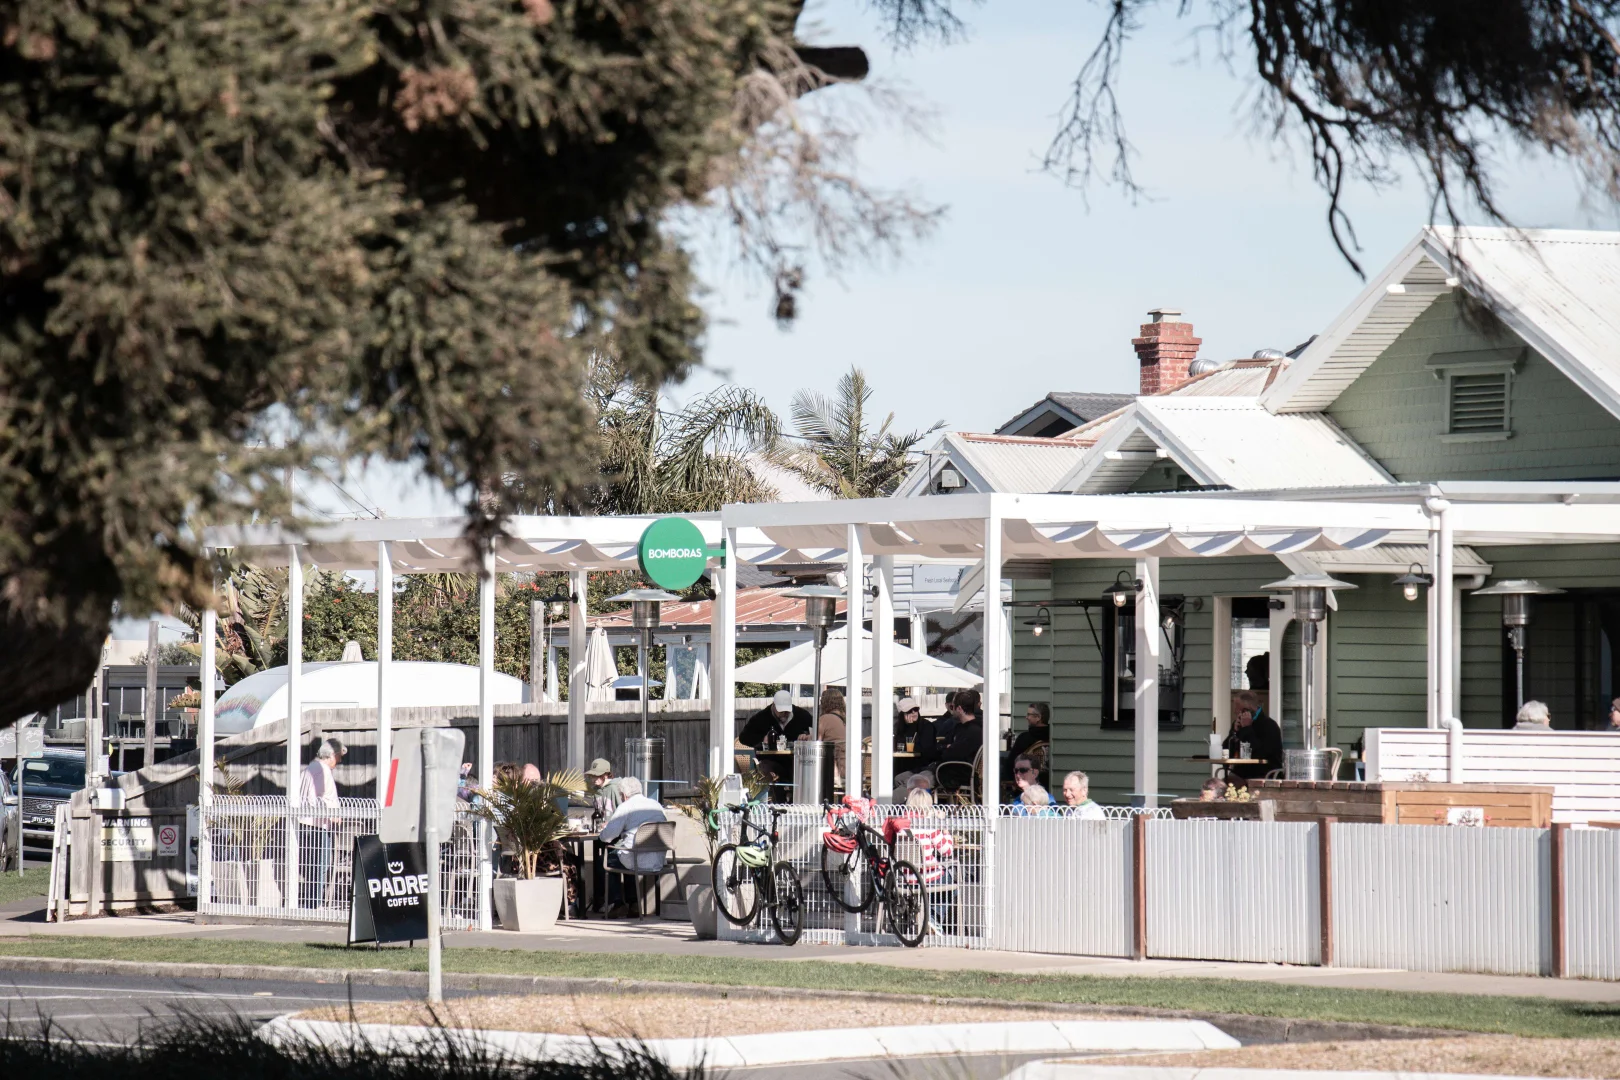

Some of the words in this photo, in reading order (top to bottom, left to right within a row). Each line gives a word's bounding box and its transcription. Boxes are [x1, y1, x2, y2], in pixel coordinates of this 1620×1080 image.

[648, 548, 702, 559] BOMBORAS
[101, 818, 148, 827] WARNING
[101, 838, 147, 847] SECURITY
[368, 874, 428, 898] PADRE
[387, 896, 419, 907] COFFEE
